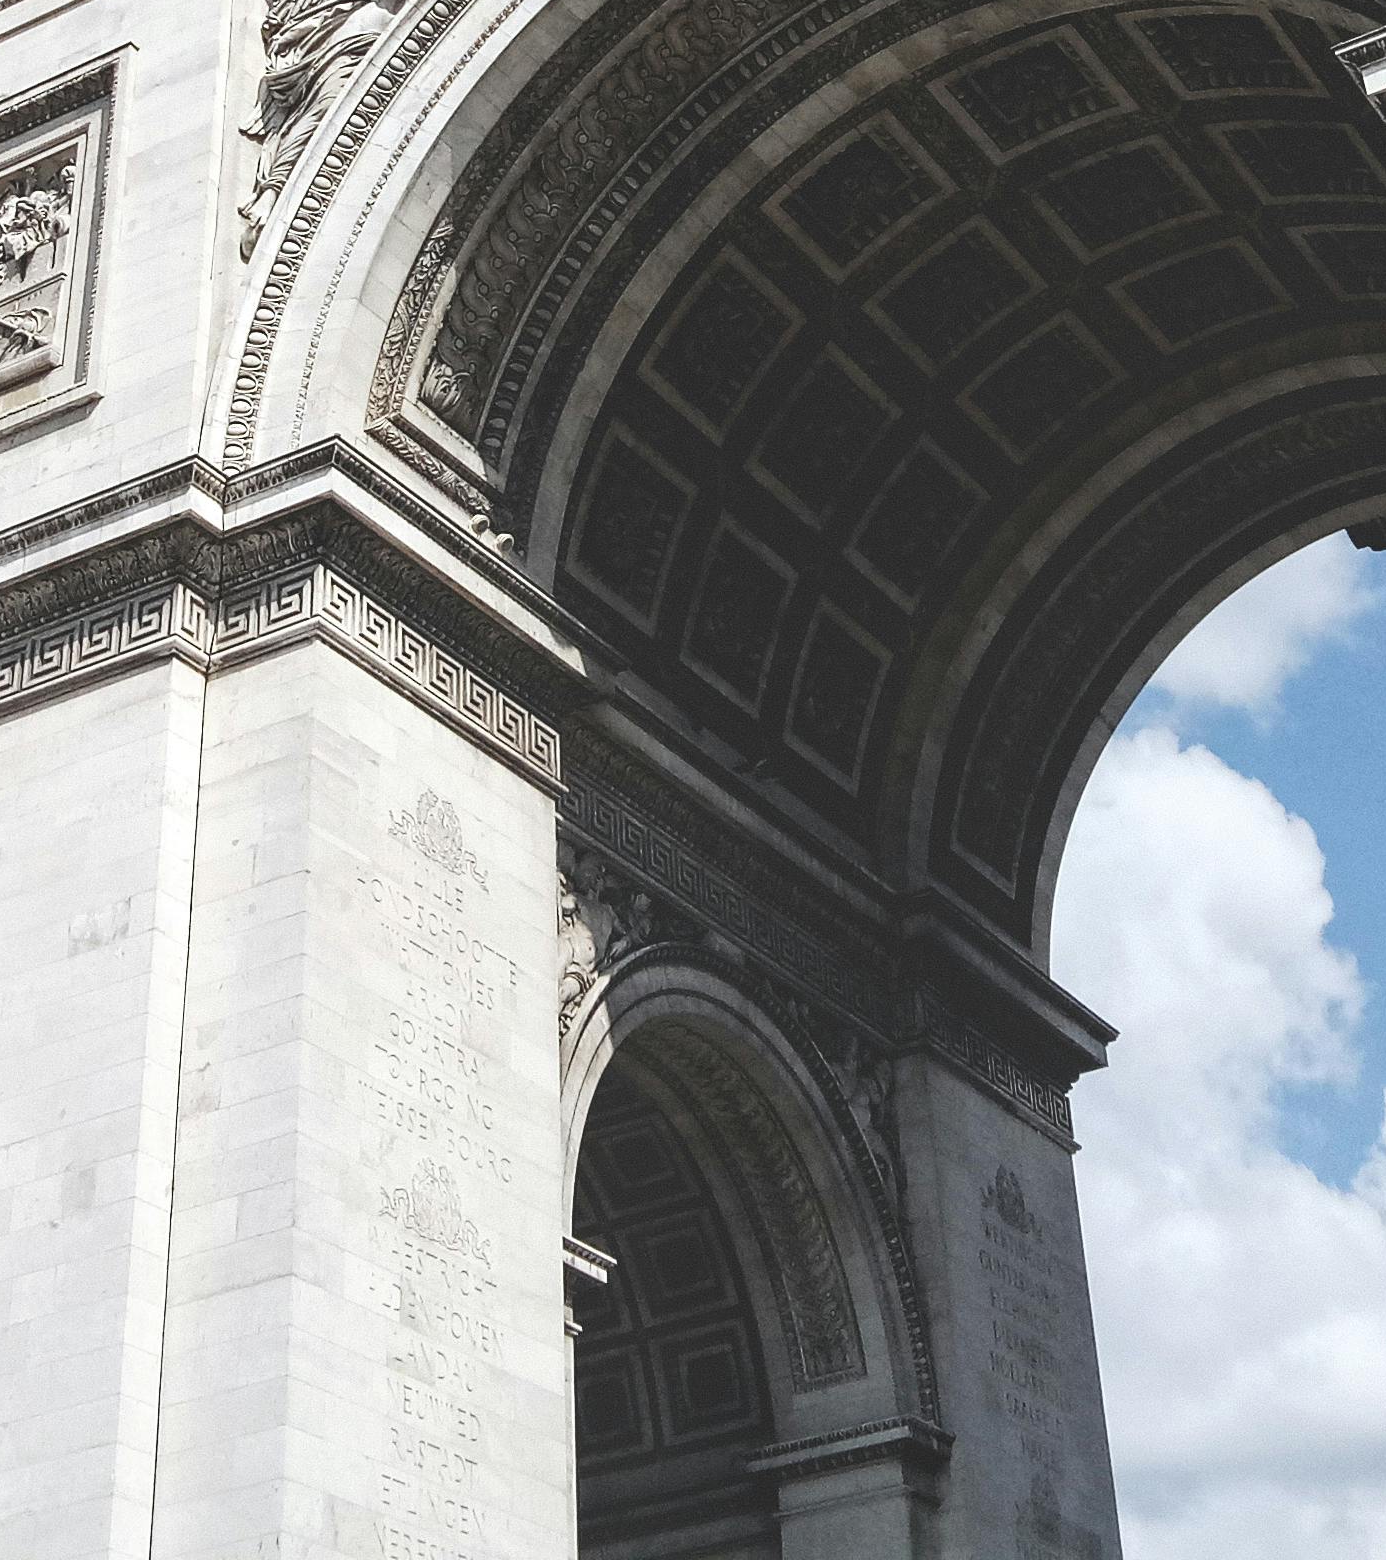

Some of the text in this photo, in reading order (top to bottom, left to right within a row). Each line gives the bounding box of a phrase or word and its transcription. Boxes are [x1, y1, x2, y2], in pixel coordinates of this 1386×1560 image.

[374, 1044, 494, 1130] TOURCONG
[388, 1012, 487, 1088] COURTRA
[387, 1378, 481, 1442] NEUWED
